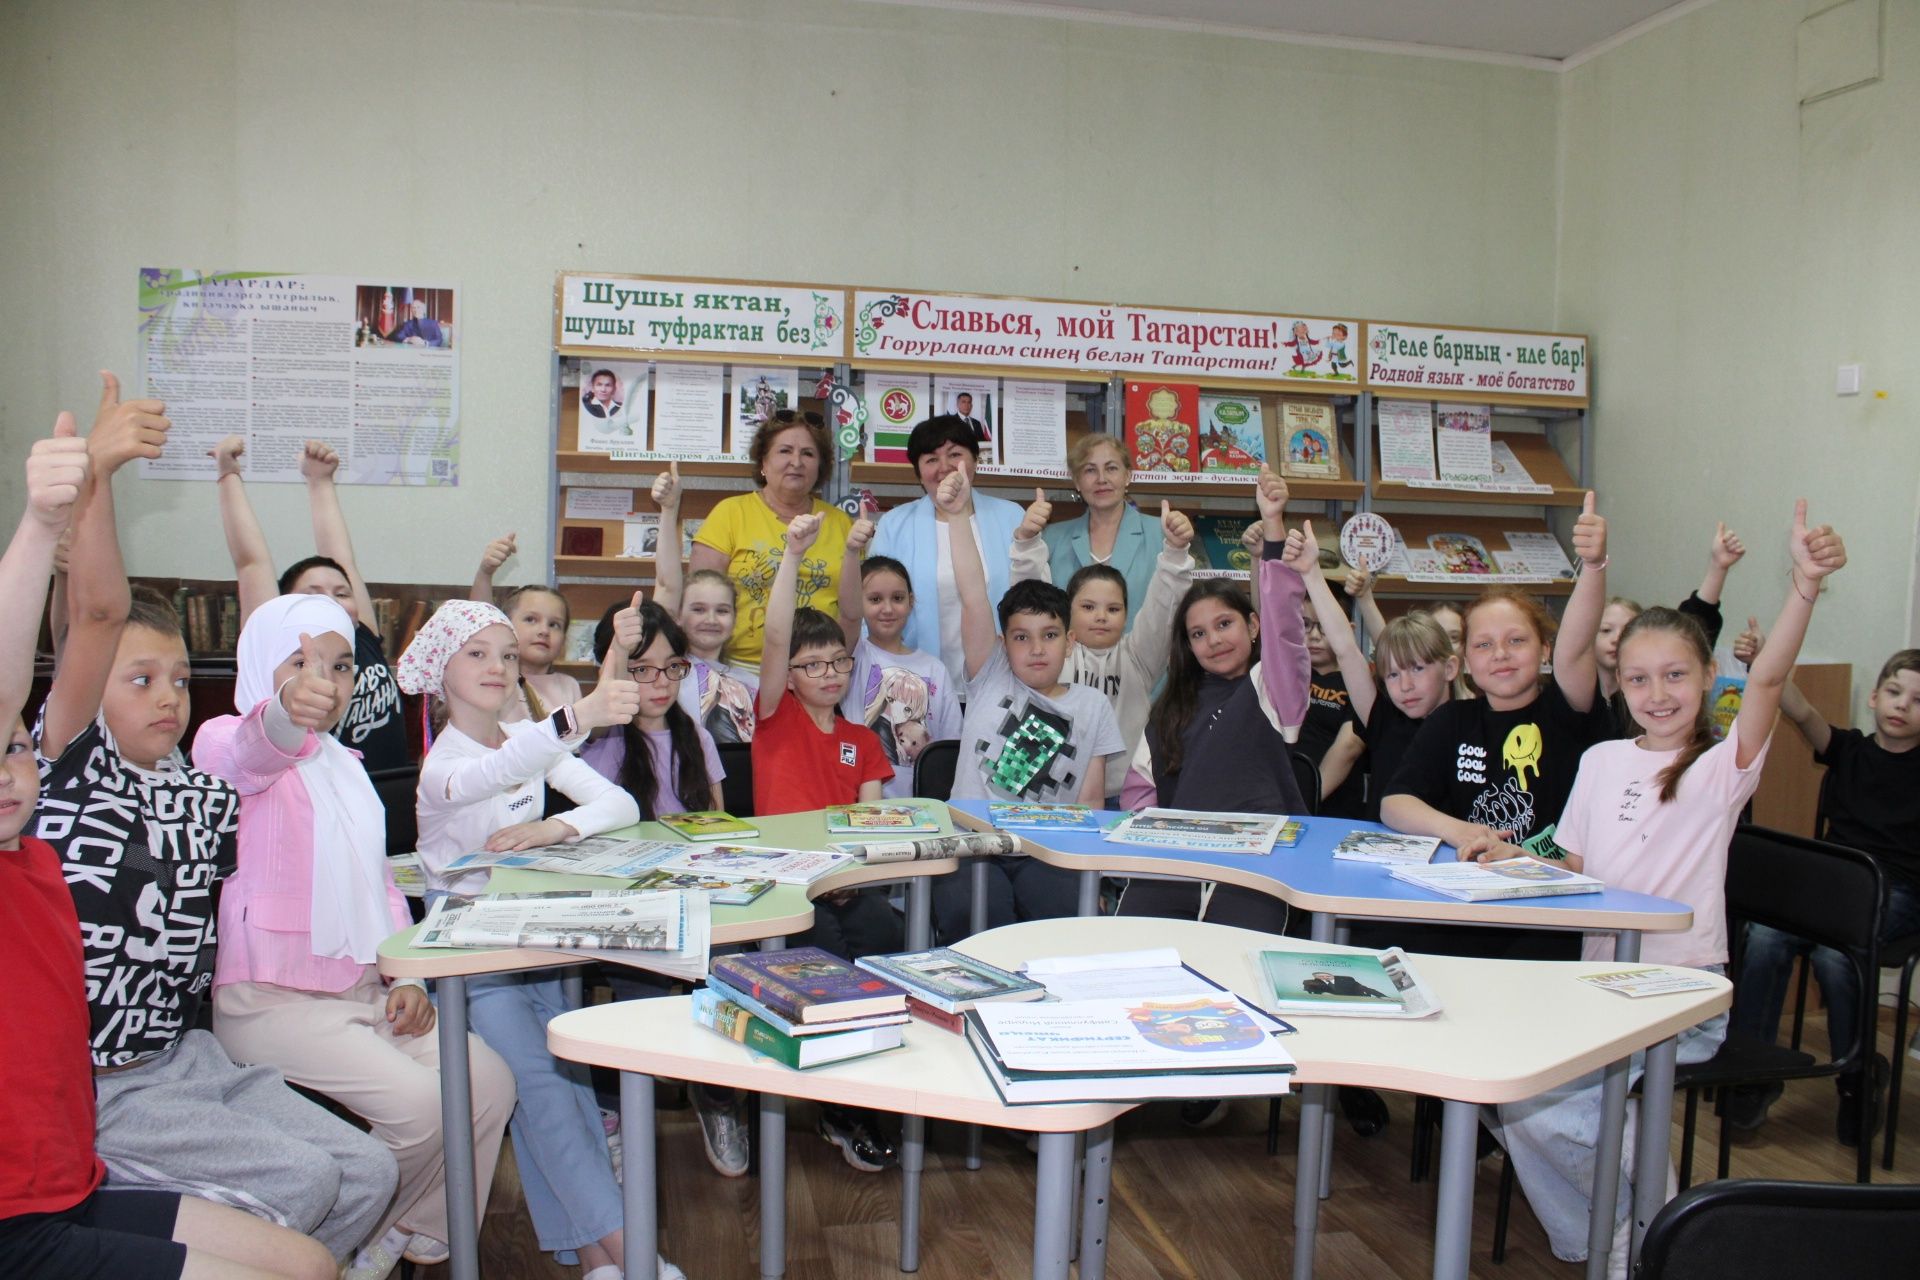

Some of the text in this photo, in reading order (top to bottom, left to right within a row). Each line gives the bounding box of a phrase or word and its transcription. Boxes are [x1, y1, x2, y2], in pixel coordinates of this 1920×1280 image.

[582, 281, 791, 317] Шушы яктан,
[564, 315, 811, 345] шушы туфрактан без
[911, 299, 1279, 353] Славься, мой Татарстан!
[879, 334, 1278, 372] Горурланам синең белән Татарстан!
[1386, 331, 1430, 357] Теле
[1433, 334, 1501, 367] барның
[1517, 345, 1547, 367] иле
[1551, 341, 1586, 373] бар!
[1369, 362, 1425, 384] Родной
[1427, 371, 1466, 387] язык
[1476, 371, 1504, 388] моё
[1507, 370, 1577, 392] богатство
[1010, 466, 1034, 475] наш
[1456, 756, 1486, 771] COOL
[1458, 743, 1487, 758] COOL
[1457, 769, 1487, 784] COOL
